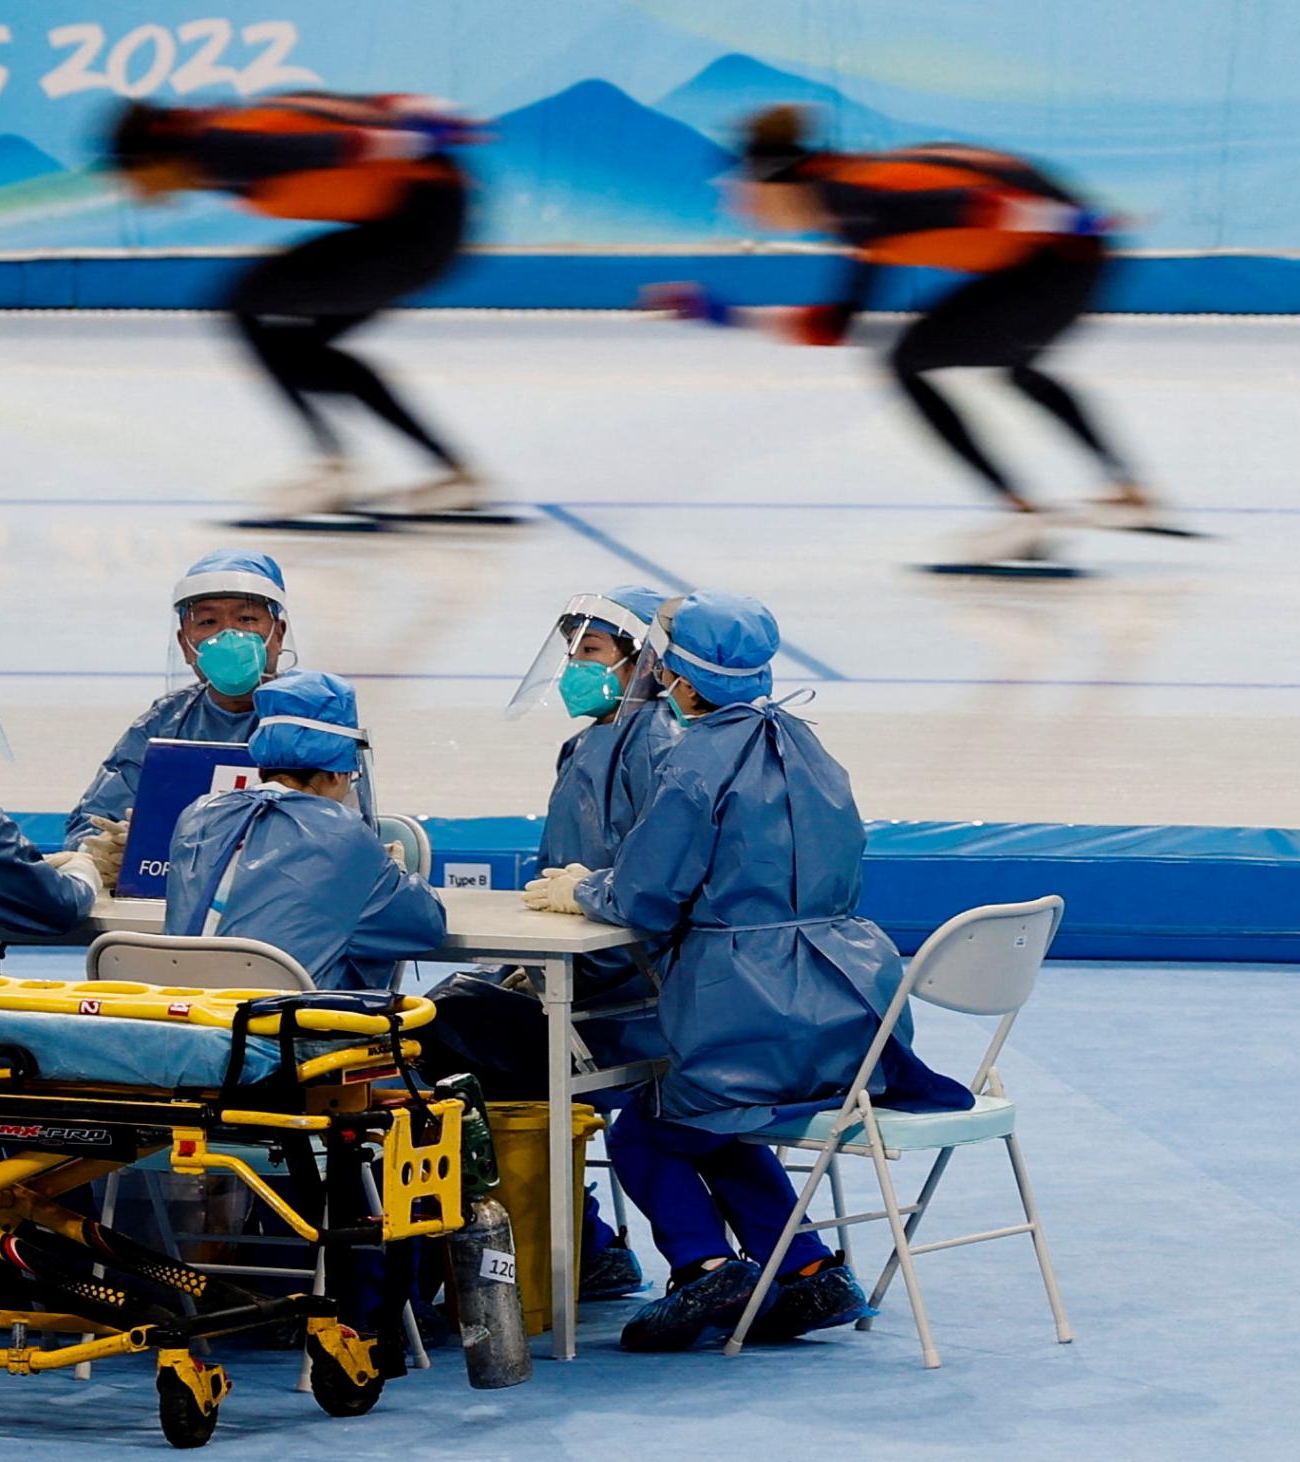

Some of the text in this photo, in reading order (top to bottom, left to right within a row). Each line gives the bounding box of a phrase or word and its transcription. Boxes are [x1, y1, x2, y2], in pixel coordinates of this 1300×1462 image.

[40, 18, 326, 98] 2022
[448, 874, 487, 888] Type B
[81, 1000, 100, 1014] 2
